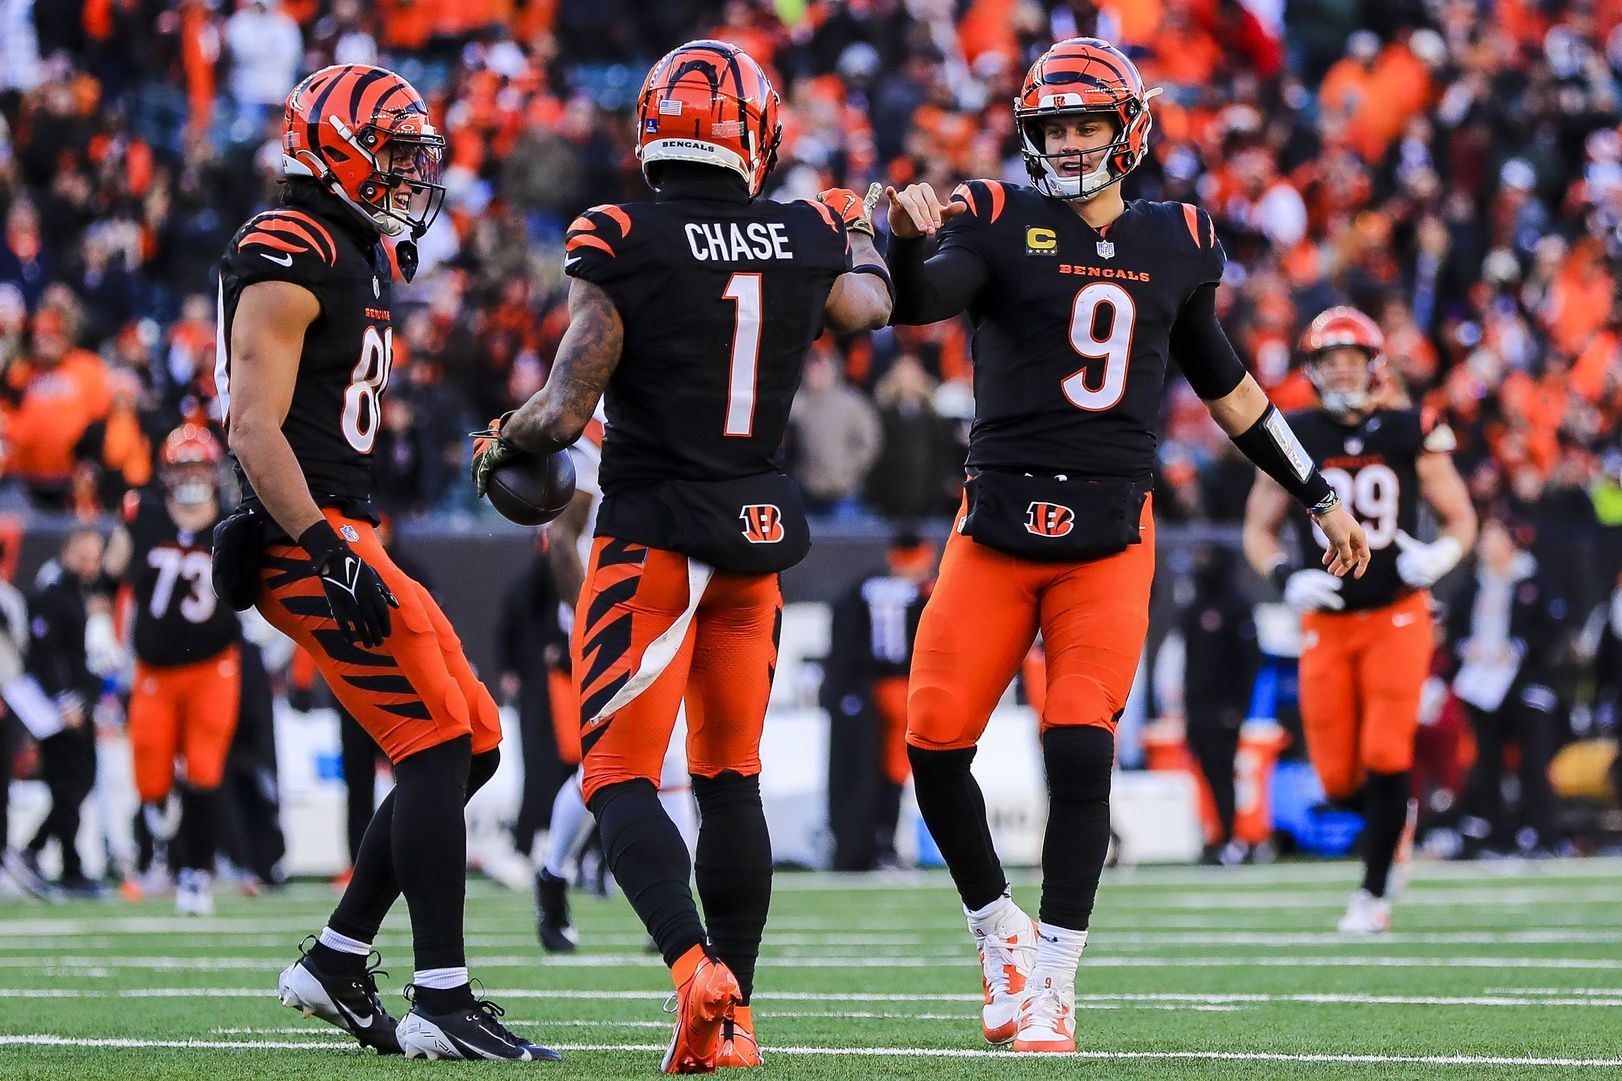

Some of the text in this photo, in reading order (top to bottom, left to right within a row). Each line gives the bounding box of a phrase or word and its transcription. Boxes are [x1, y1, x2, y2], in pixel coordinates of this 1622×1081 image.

[662, 141, 715, 153] BENGALS
[684, 222, 793, 262] CHASE
[1027, 227, 1057, 249] C
[1059, 264, 1151, 282] BENGALS
[721, 272, 763, 437] 1
[1060, 281, 1137, 412] 9
[341, 325, 393, 454] 8
[739, 504, 785, 544] B
[1023, 501, 1075, 538] B
[146, 545, 217, 623] 73
[1044, 977, 1052, 989] 9
